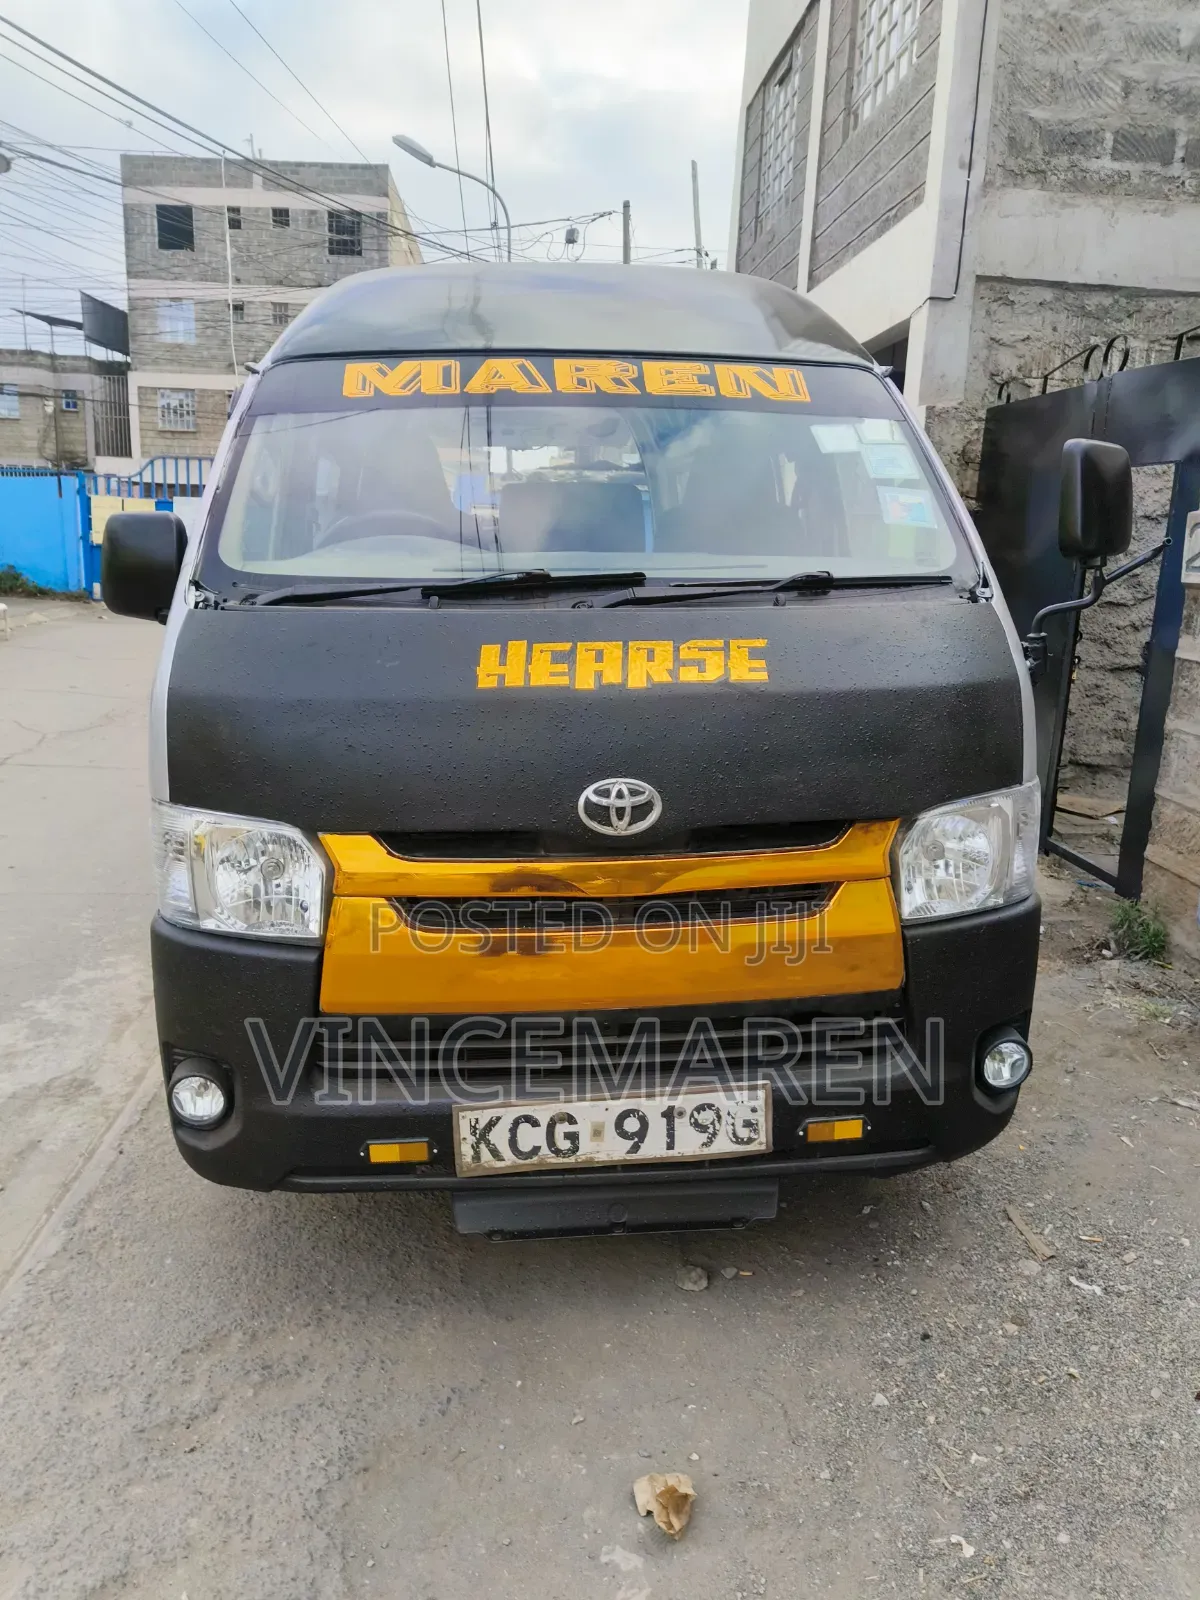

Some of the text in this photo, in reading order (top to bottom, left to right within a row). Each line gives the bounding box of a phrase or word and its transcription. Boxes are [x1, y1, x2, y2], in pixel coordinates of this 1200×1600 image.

[342, 358, 811, 402] MAREN
[476, 638, 769, 689] HEARSE
[469, 1102, 760, 1163] KCG 919G
